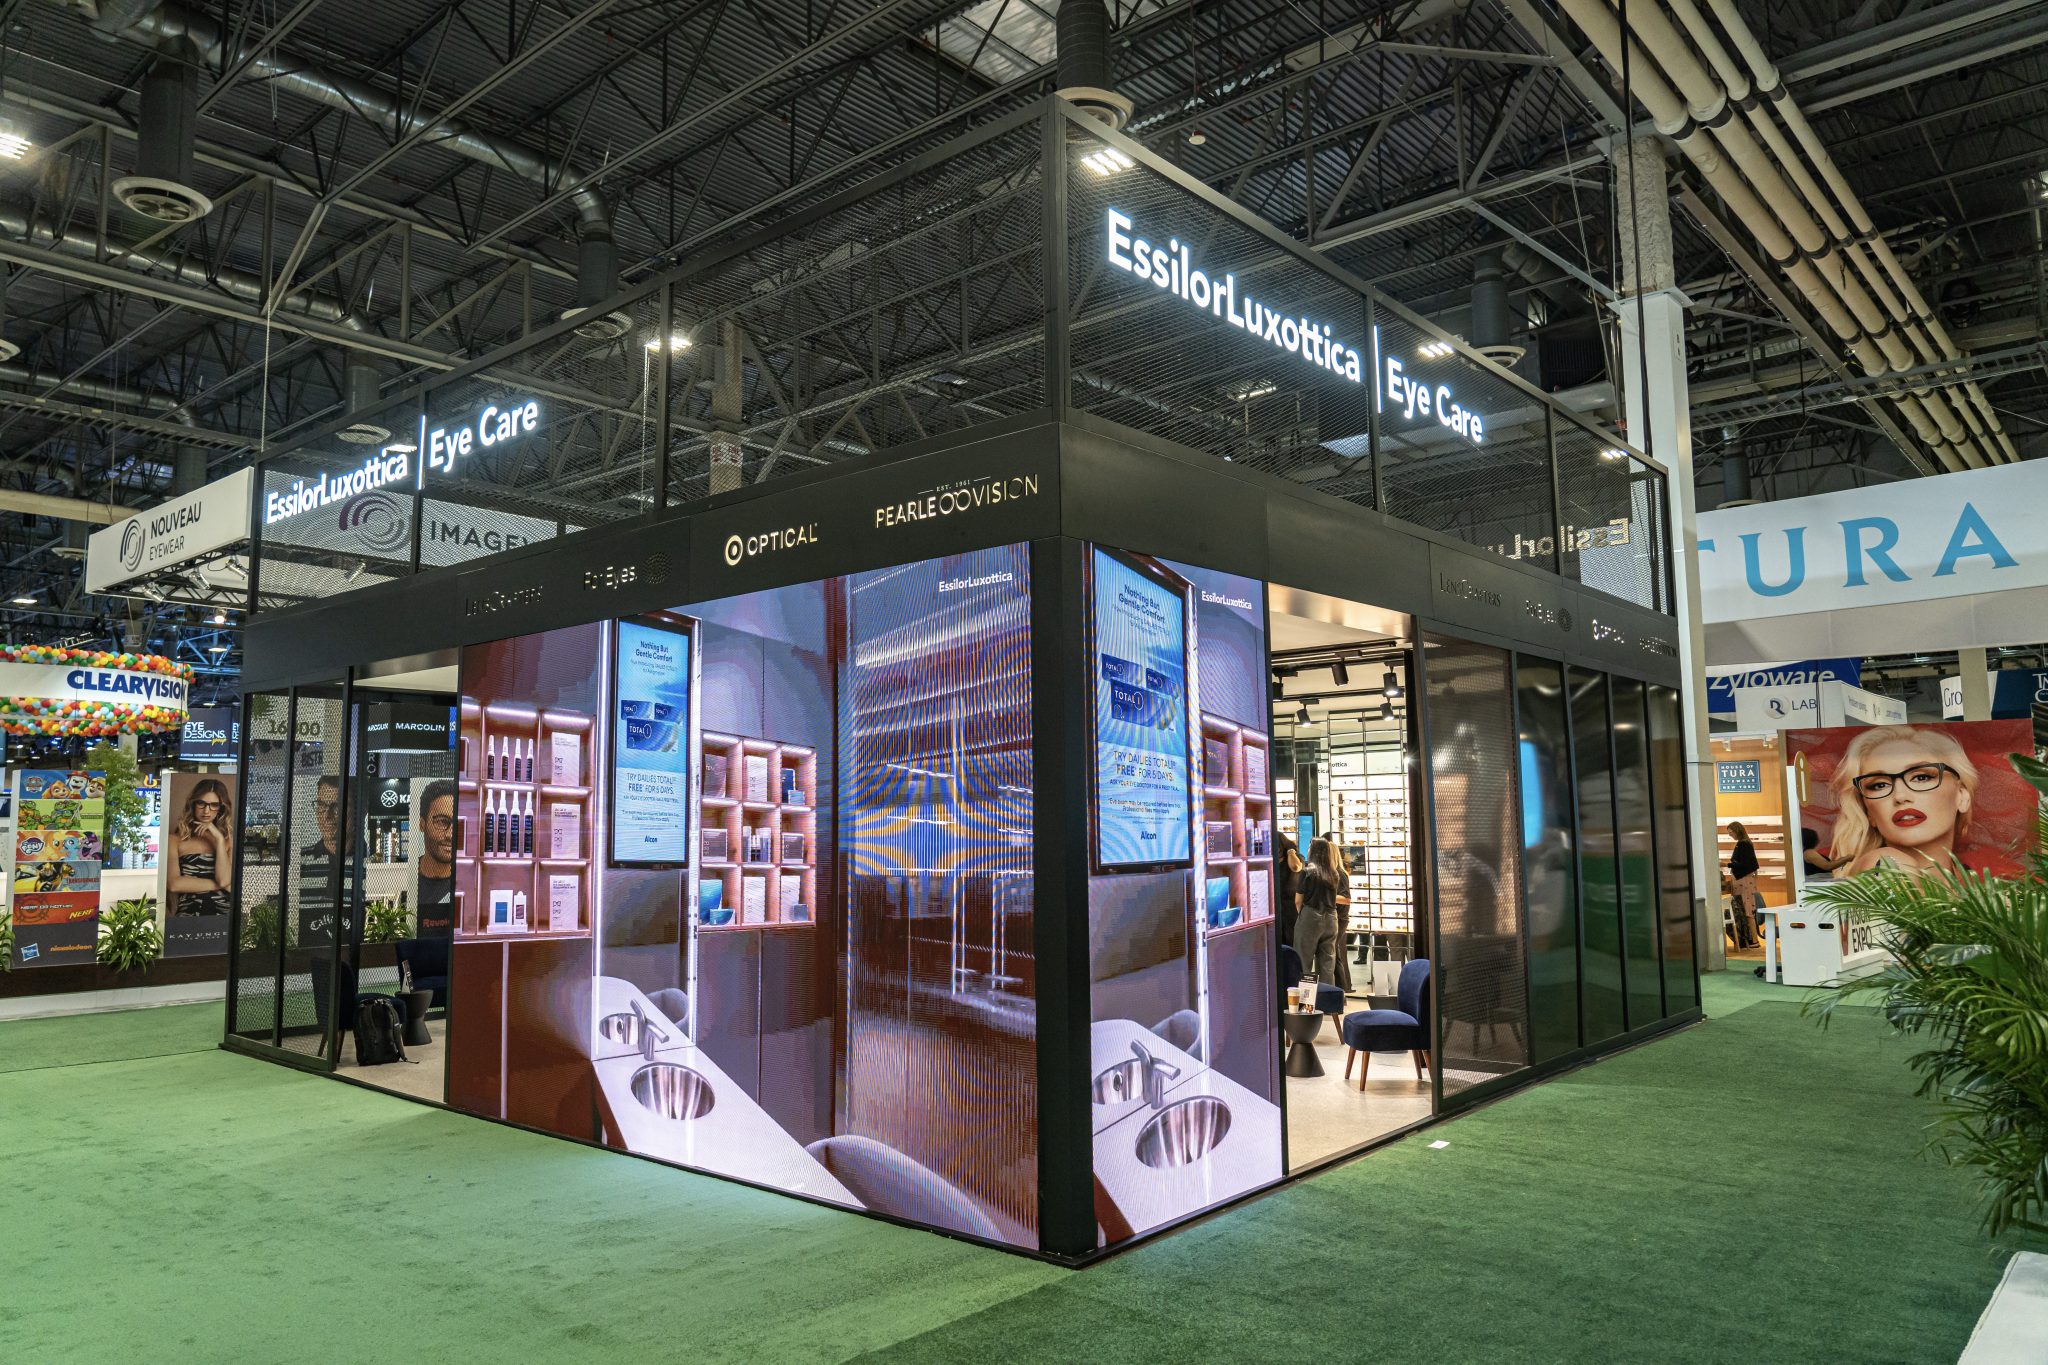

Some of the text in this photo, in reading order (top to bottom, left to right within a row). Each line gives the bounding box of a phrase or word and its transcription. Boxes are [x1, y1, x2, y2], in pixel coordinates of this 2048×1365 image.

[1107, 207, 1485, 443] EssilorLuxottica Eye Care
[265, 401, 538, 524] EssilorLuxottica Eye Care
[875, 473, 1038, 528] PEARLE VISION
[150, 500, 202, 538] NOUVEAU
[149, 535, 185, 561] EYEWEAR
[747, 524, 818, 556] OPTICAL
[1697, 501, 2020, 597] URA
[938, 570, 1013, 592] EssilorLuxottica
[1124, 584, 1149, 606] Nothing
[1201, 590, 1253, 610] EssilorLuxottica
[1118, 593, 1140, 611] Gentle
[1141, 604, 1165, 623] Comfort
[652, 651, 673, 662] Comfort
[1791, 699, 1818, 711] LAB
[184, 721, 205, 731] EYE
[395, 722, 446, 732] MARCOLIN
[1114, 750, 1127, 762] TRY
[1128, 753, 1152, 766] DAILIES
[1138, 767, 1151, 778] FOR
[1721, 769, 1755, 778] TURA
[1140, 830, 1157, 841] Alcon
[69, 908, 95, 919] NERF
[1851, 925, 1872, 953] EXPO
